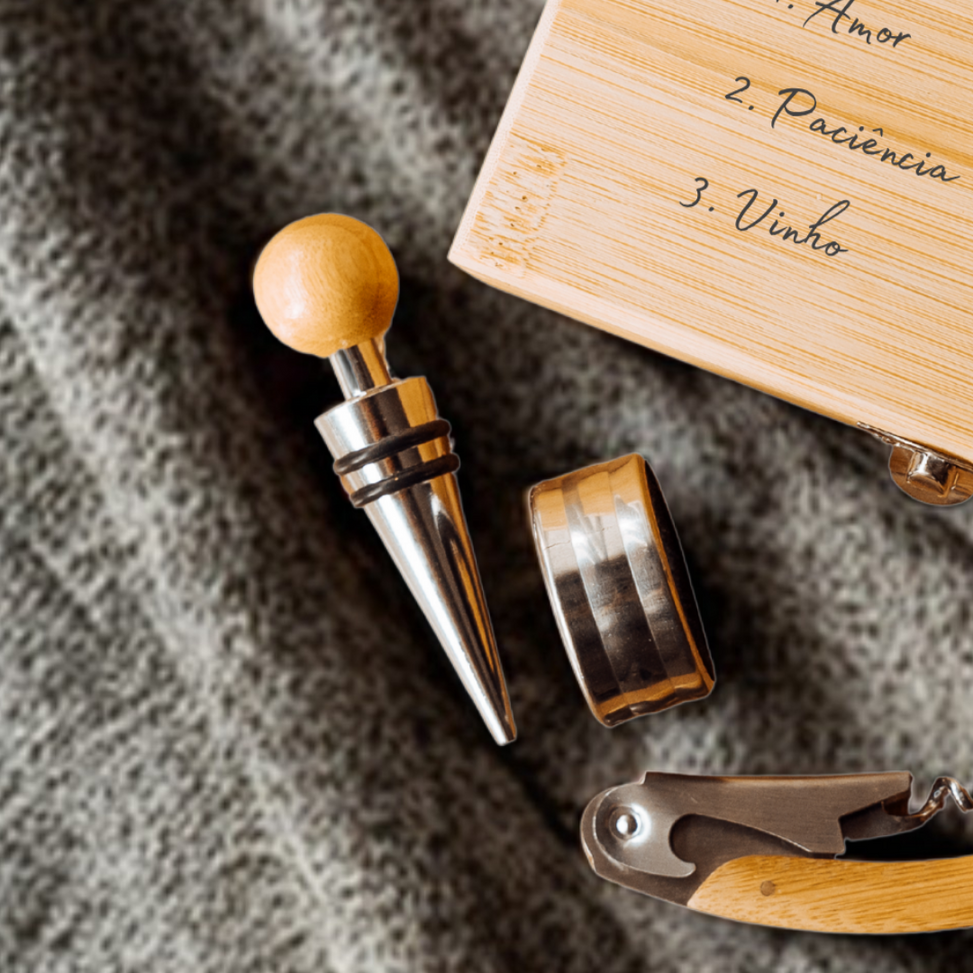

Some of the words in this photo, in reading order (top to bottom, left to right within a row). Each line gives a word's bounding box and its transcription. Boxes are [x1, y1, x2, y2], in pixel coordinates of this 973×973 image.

[724, 76, 755, 110] 2.
[771, 87, 960, 182] Paciência
[679, 177, 715, 212] 3.
[735, 188, 850, 257] Vinho
